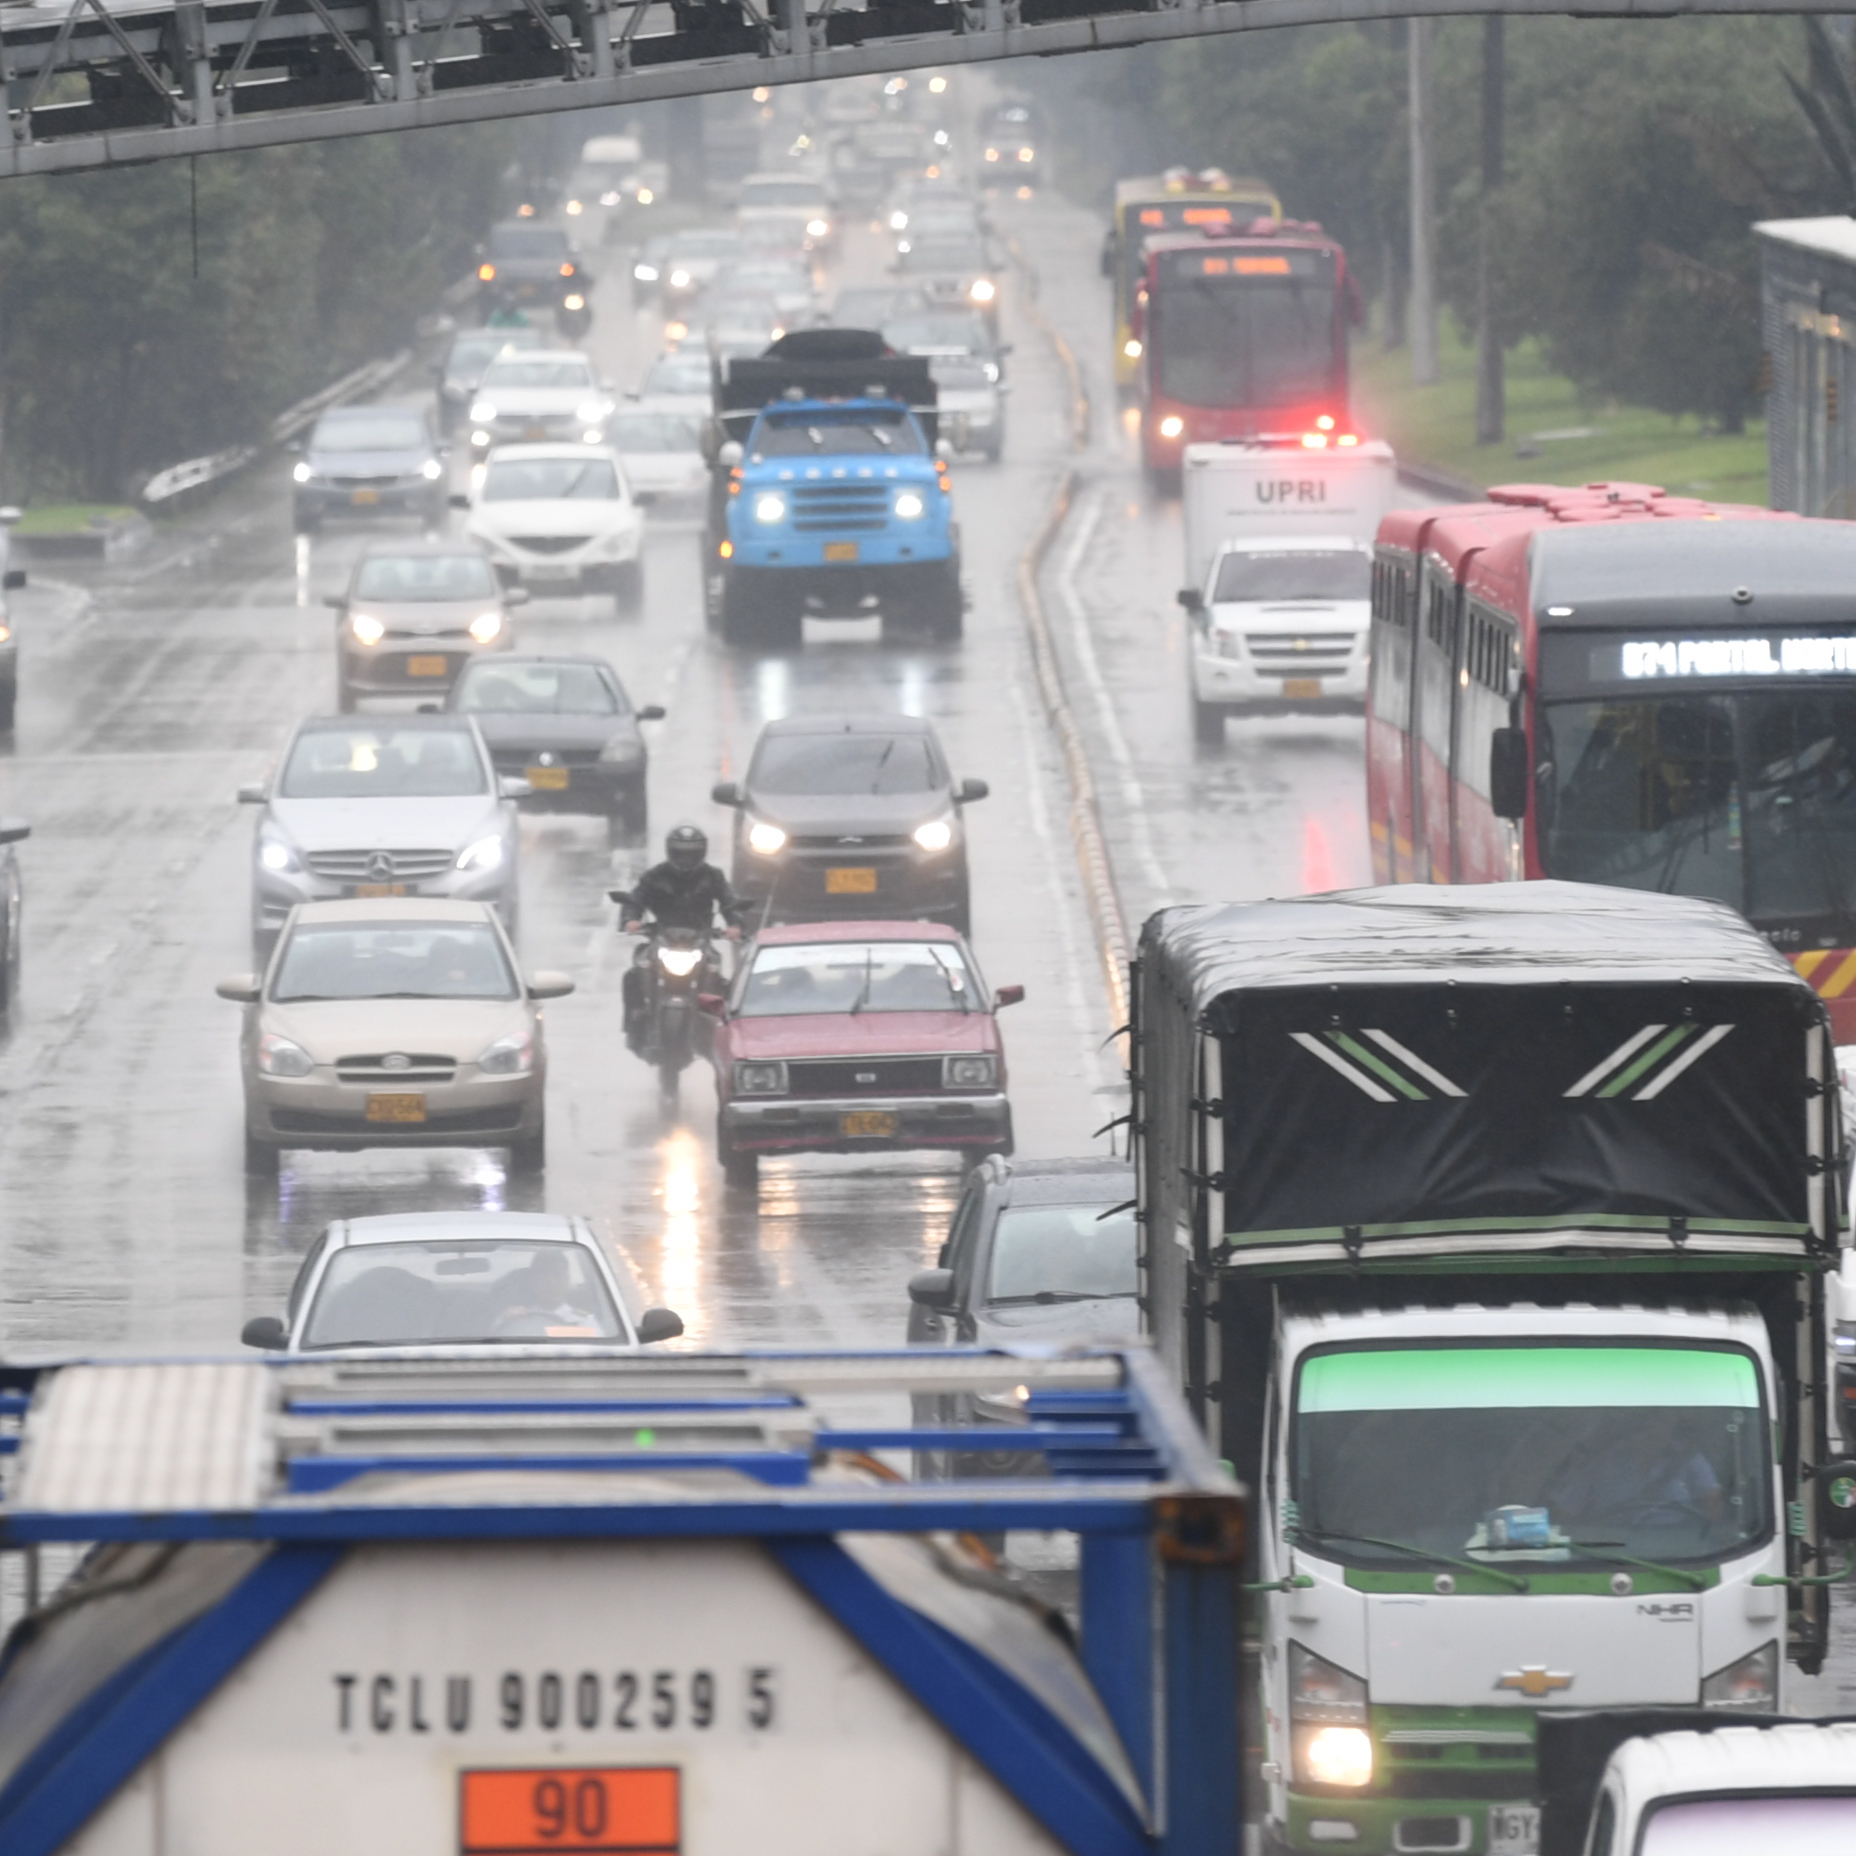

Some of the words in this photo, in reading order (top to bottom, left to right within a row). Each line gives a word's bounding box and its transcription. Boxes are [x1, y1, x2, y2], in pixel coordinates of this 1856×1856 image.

[1255, 480, 1326, 504] UPRI
[1678, 639, 1780, 674] PORTAL
[1637, 1603, 1693, 1616] NHR
[334, 1672, 471, 1734] TCLU
[498, 1670, 716, 1732] 900259
[747, 1667, 776, 1731] 5
[532, 1777, 609, 1839] 90
